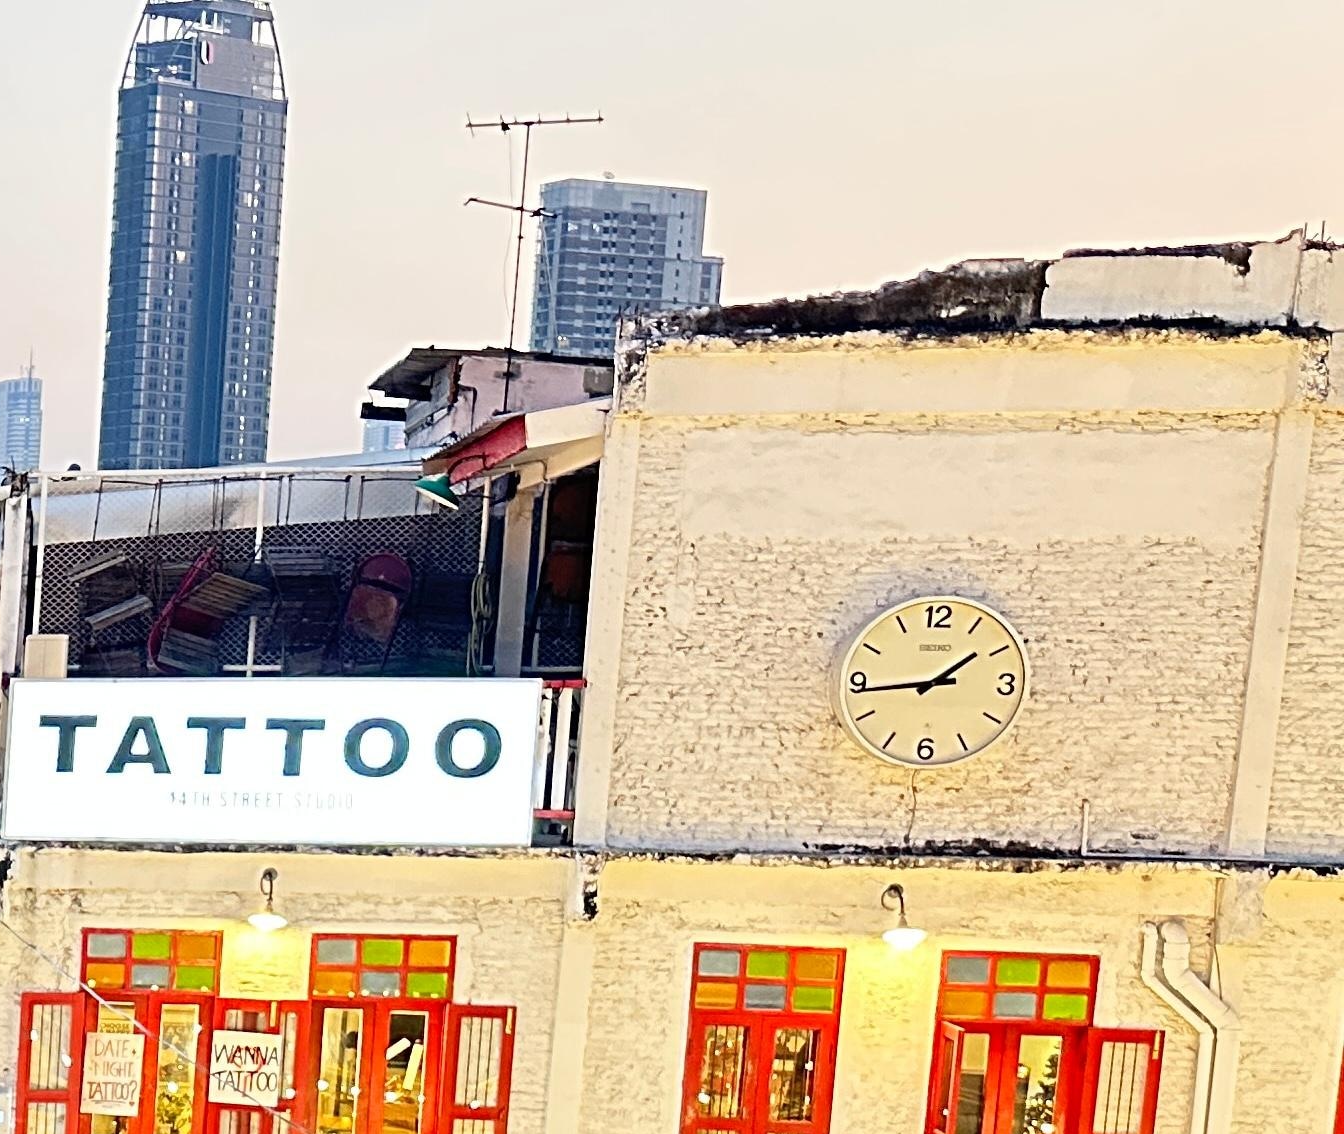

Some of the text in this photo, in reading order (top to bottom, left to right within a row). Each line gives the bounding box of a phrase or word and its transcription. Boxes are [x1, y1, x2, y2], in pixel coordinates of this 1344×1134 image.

[925, 605, 953, 629] 12
[919, 644, 952, 652] SEIKO
[849, 671, 867, 693] 9
[996, 673, 1016, 696] 3
[39, 714, 503, 779] TATTOO
[916, 737, 935, 761] 6
[219, 791, 282, 809] STREET
[94, 1039, 130, 1058] DATE
[214, 1044, 279, 1067] WANNA
